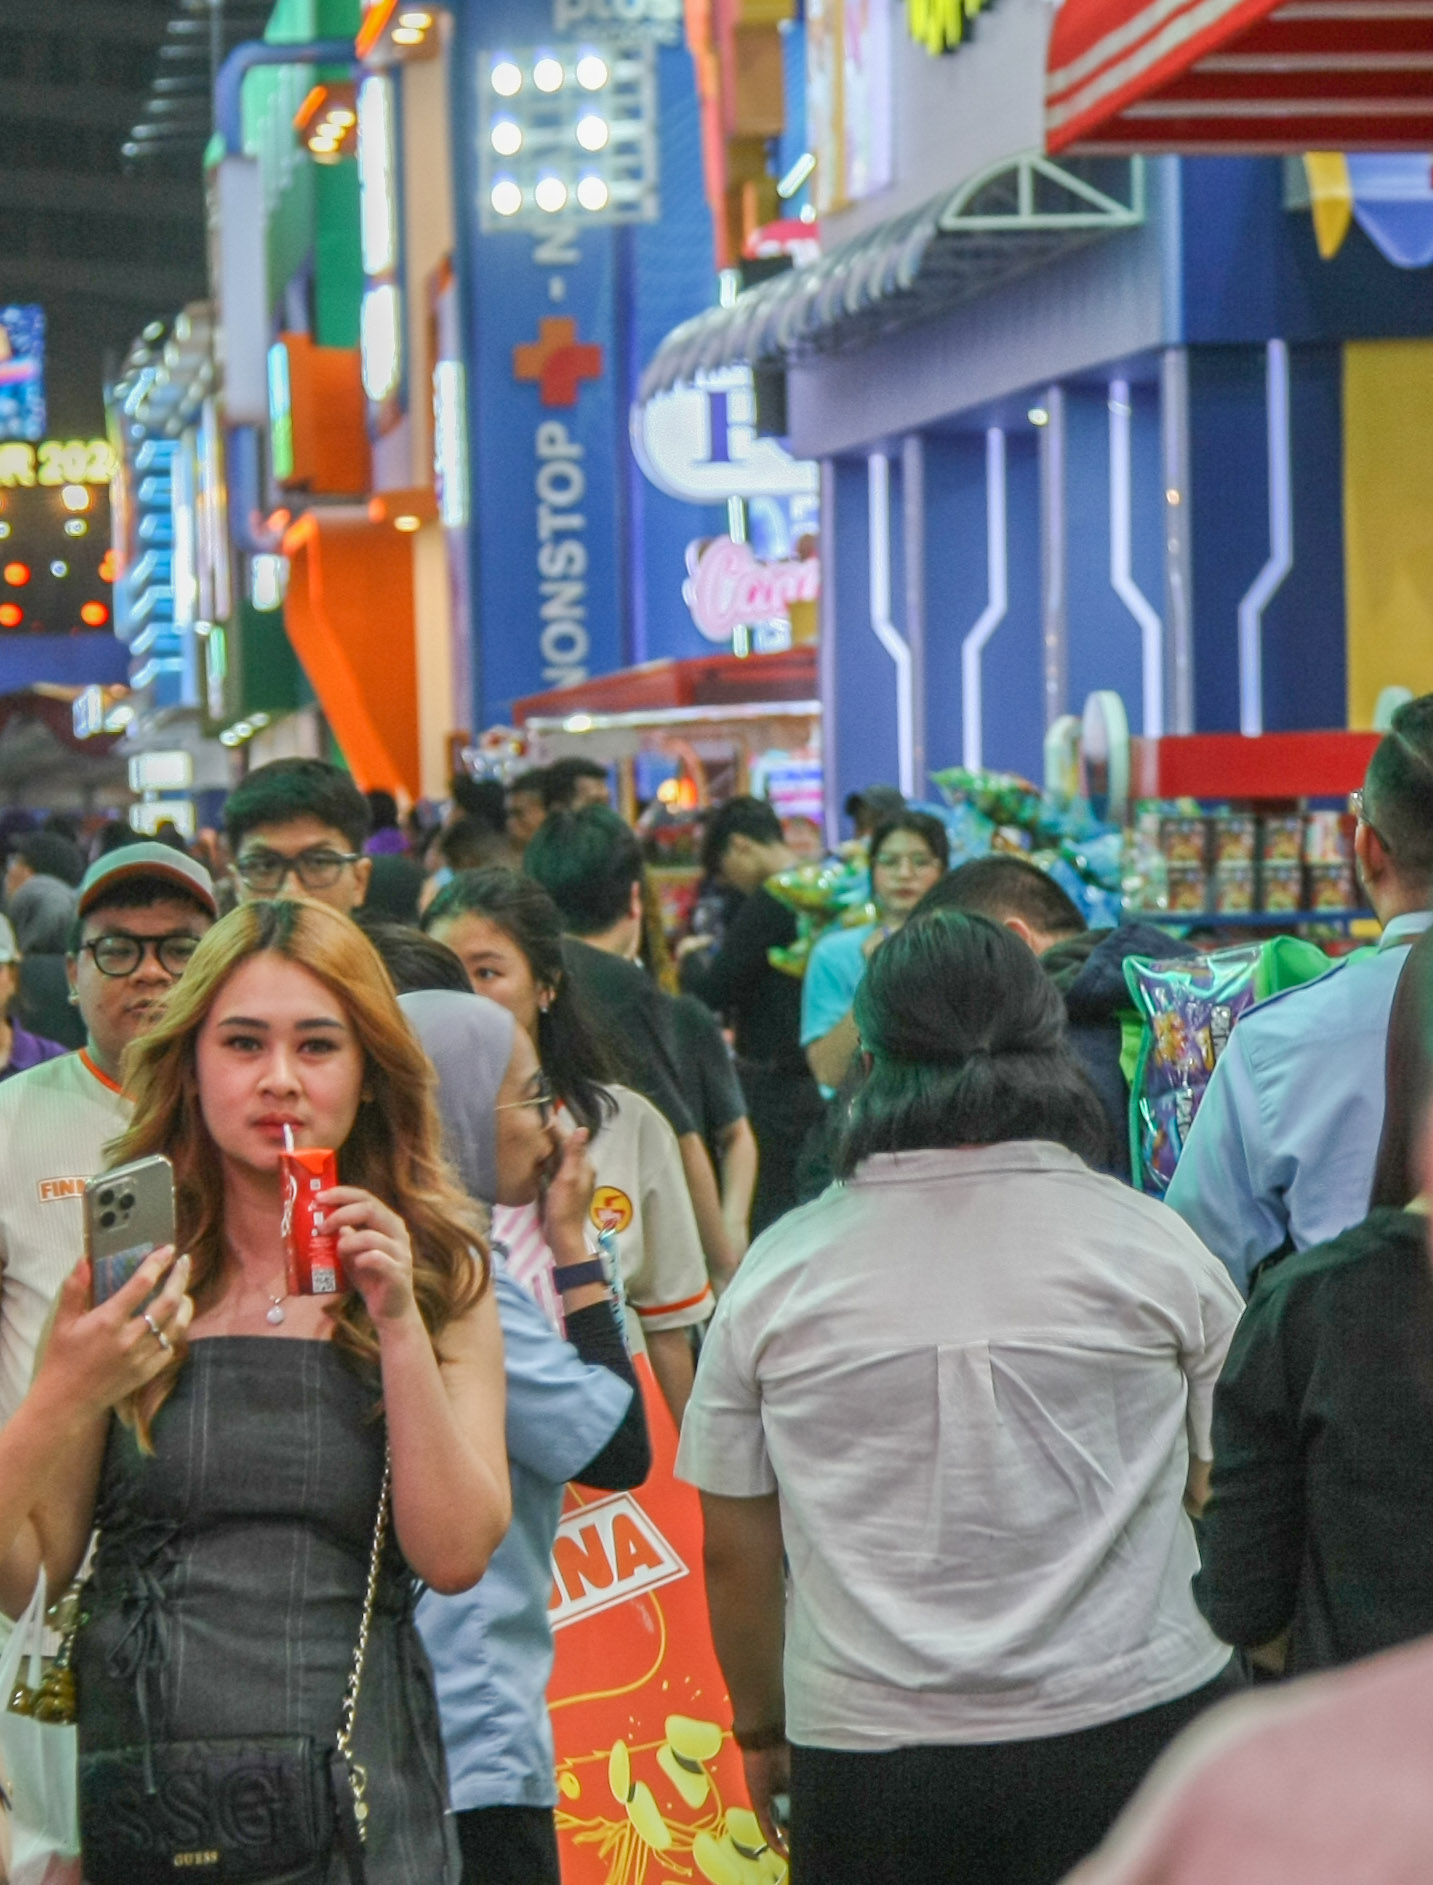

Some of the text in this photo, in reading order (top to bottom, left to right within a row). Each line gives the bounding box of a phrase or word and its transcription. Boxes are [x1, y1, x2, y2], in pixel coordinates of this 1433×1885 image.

[37, 438, 116, 486] 202
[547, 1513, 665, 1612] NA
[173, 1852, 219, 1867] GUESS
